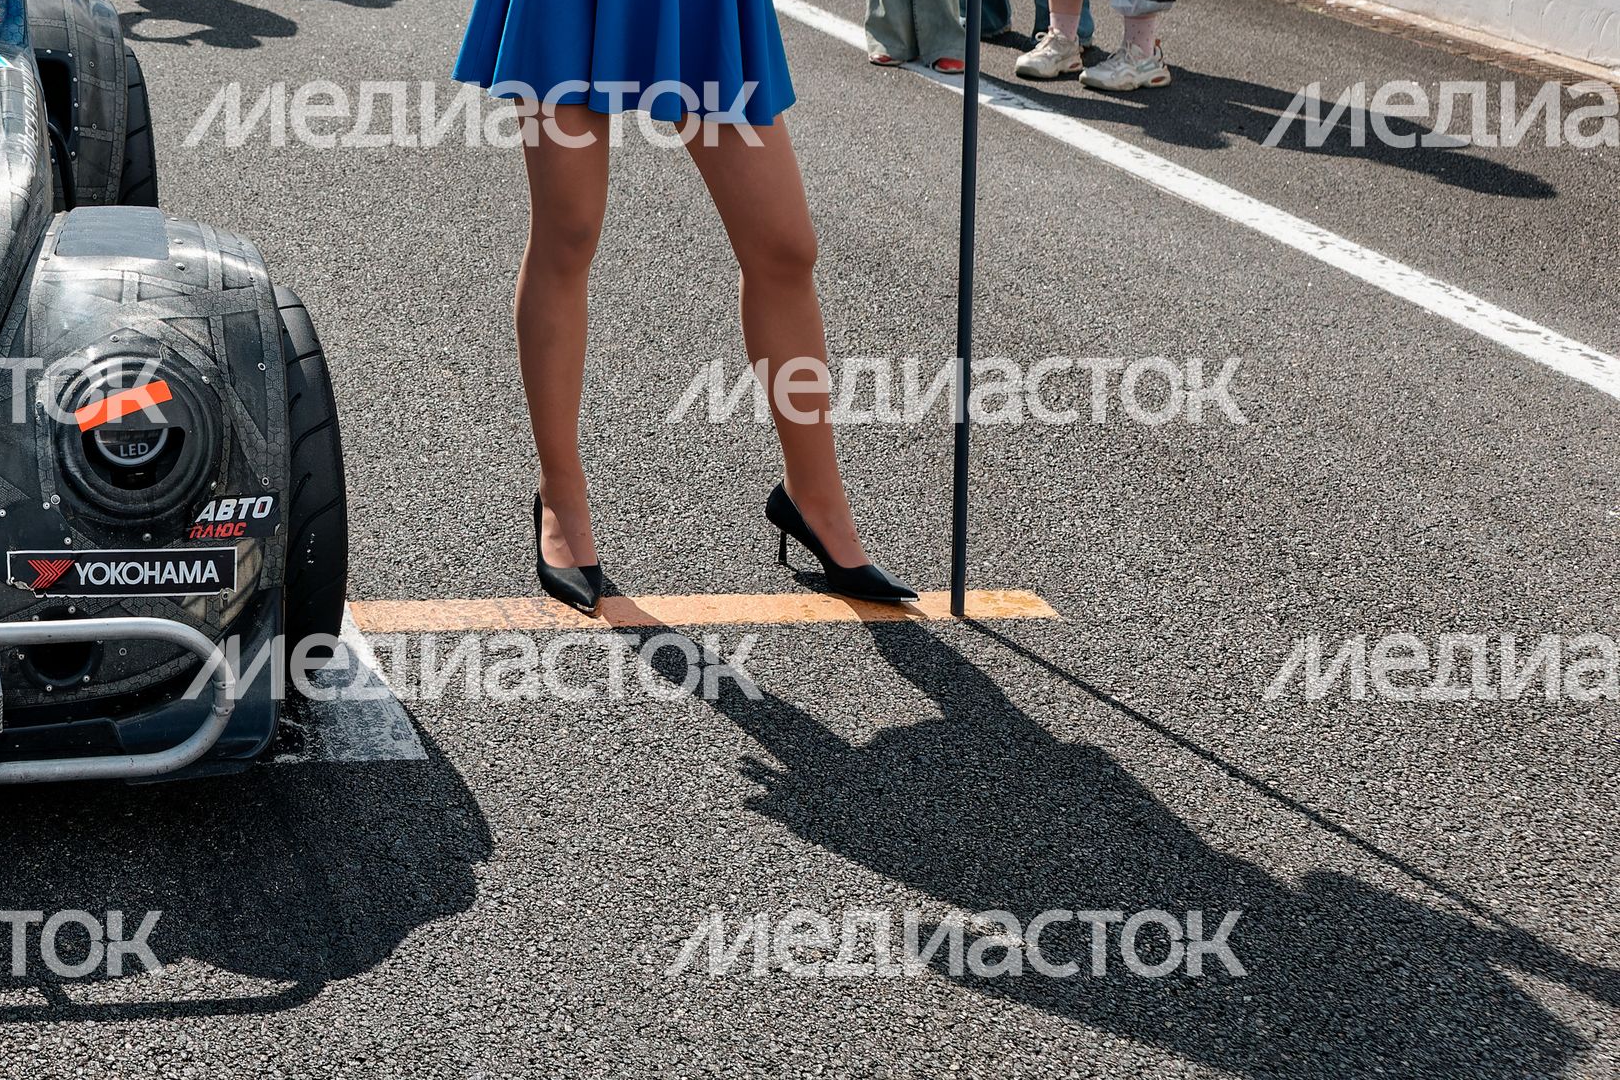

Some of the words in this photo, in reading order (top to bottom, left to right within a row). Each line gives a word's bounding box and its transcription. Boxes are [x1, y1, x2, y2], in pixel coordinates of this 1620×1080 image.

[118, 441, 149, 459] LED
[195, 496, 274, 524] АВТО
[73, 561, 220, 587] YOKOHAMA
